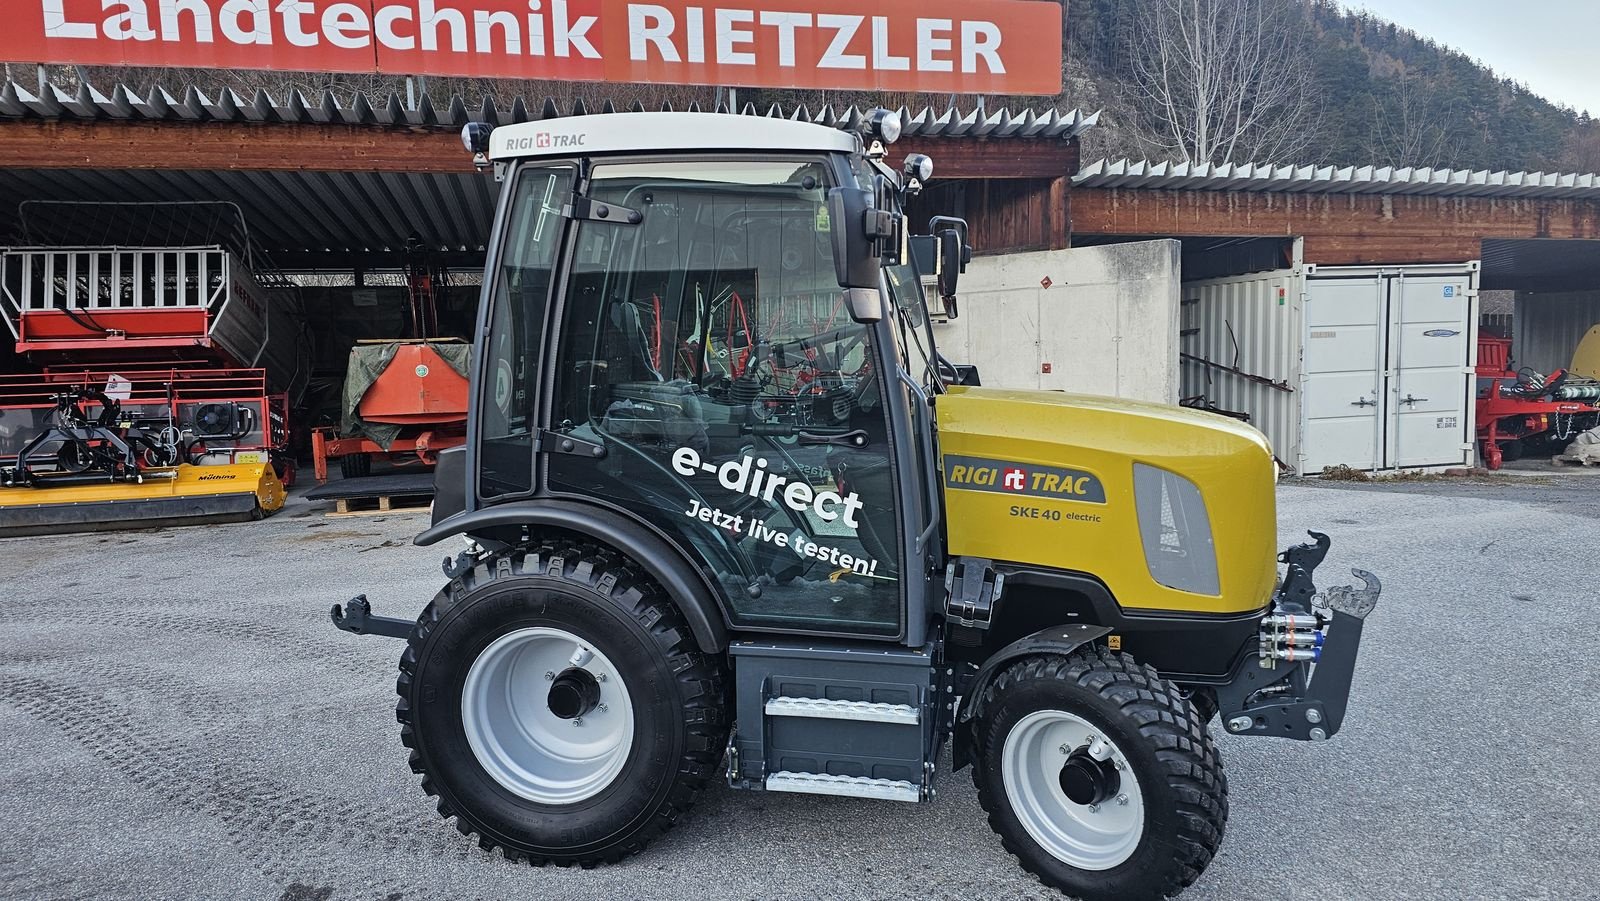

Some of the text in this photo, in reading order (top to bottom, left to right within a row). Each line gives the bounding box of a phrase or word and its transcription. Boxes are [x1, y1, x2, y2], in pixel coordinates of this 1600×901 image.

[43, 0, 1007, 75] Landtechnik RIETZLER
[506, 137, 533, 151] RIGI
[552, 133, 586, 147] TRAC
[671, 446, 864, 529] e-direct
[950, 464, 998, 486] RIGI
[1031, 472, 1091, 495] TRAC
[685, 499, 878, 577] Jetzt live testen!
[1009, 505, 1101, 523] SKE 40 electric
